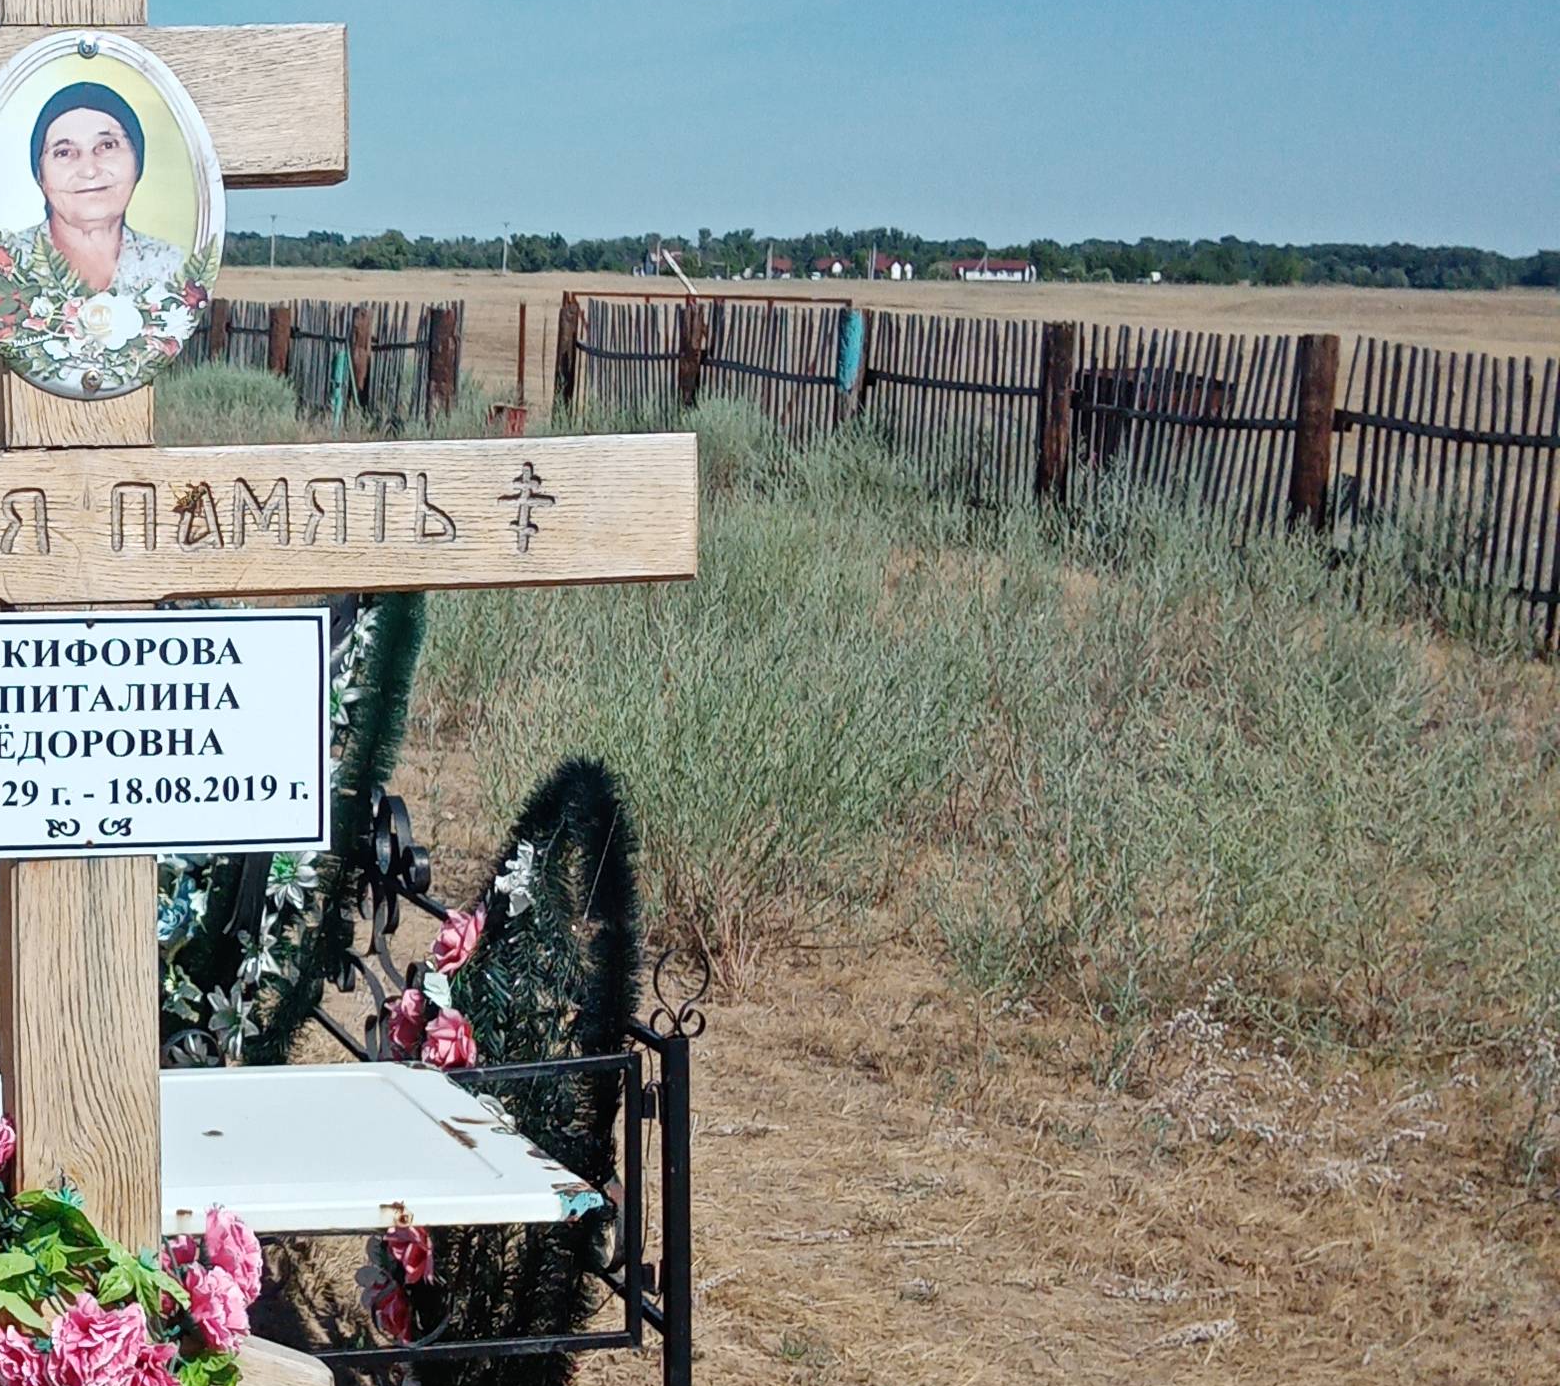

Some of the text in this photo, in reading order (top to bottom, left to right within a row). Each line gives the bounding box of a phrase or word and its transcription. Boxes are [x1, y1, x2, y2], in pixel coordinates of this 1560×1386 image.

[110, 471, 457, 553] ПАМЯТЬ
[50, 787, 72, 807] г.
[108, 774, 278, 805] 18.08.2019
[288, 780, 309, 801] г.
